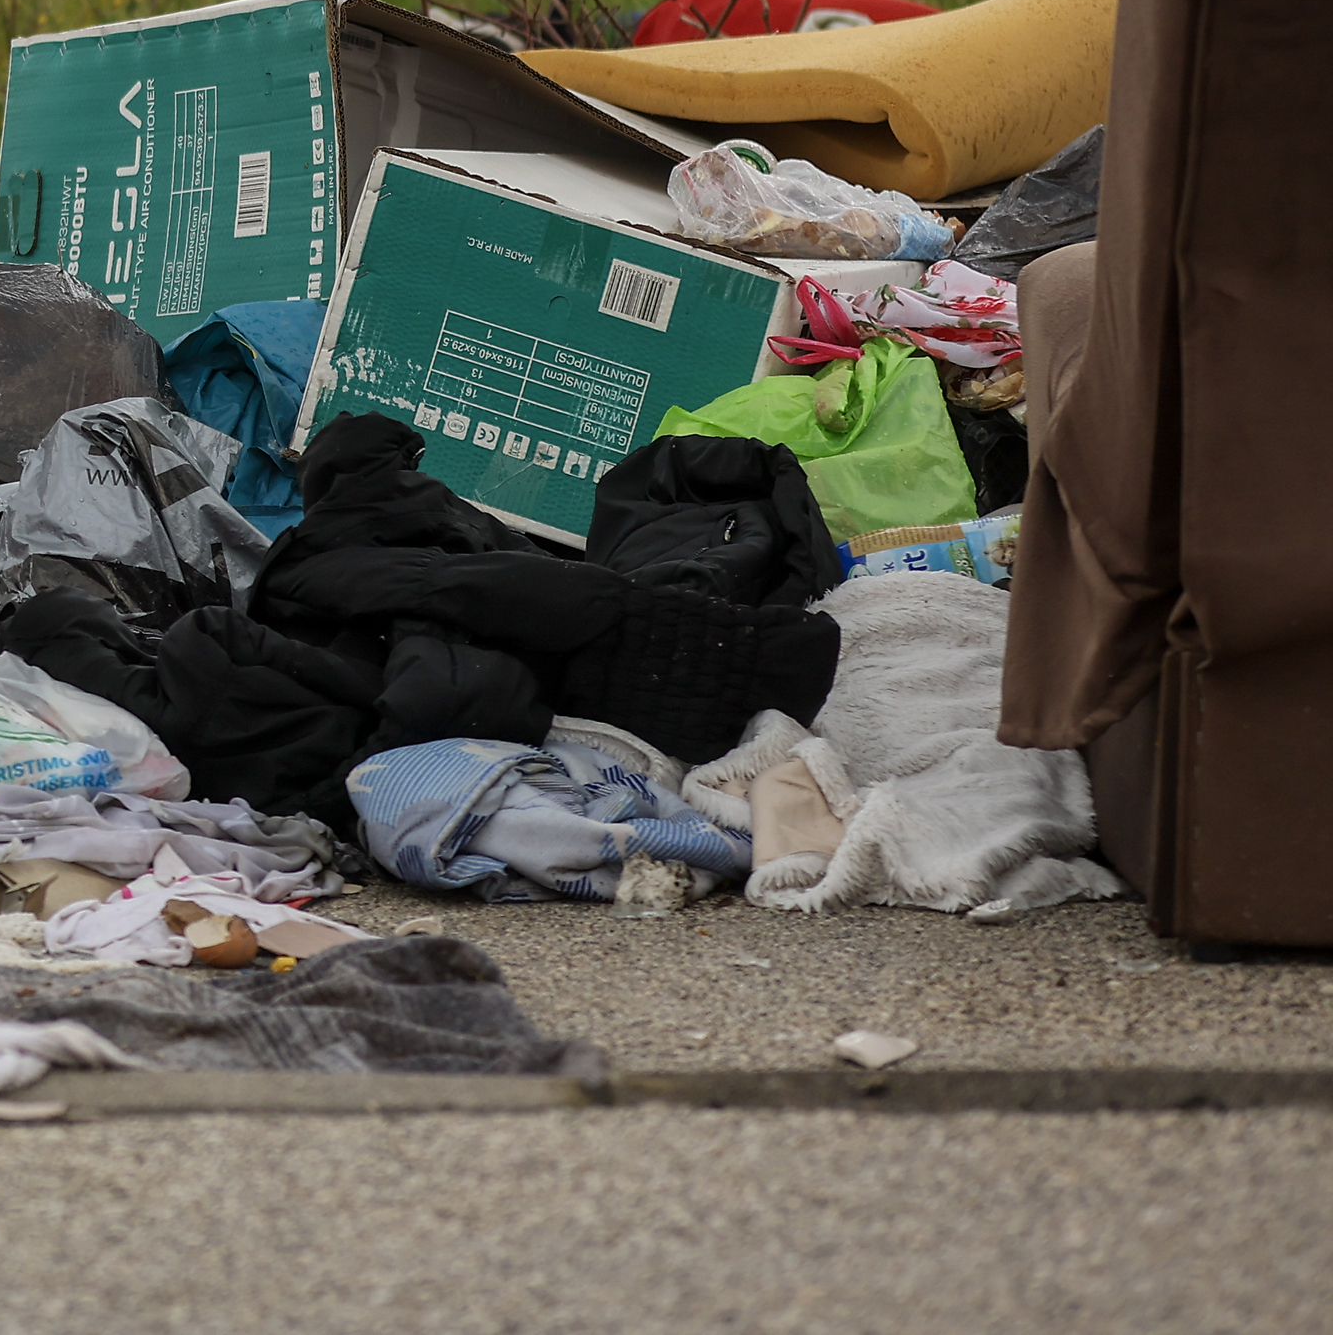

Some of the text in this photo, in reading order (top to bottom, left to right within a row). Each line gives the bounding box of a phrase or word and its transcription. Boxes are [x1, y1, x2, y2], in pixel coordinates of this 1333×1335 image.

[144, 78, 155, 195] CONDITIONER
[177, 135, 184, 149] 40
[187, 134, 194, 148] 37
[140, 200, 151, 229] AIR
[467, 236, 533, 264] MADE IN P.R.C.
[442, 337, 639, 408] DIMENSIONS(cm) 116.5x40.5x29.5
[486, 329, 645, 389] QUANTITY(PCS) 1
[471, 368, 483, 380] 13
[464, 388, 478, 399] 16
